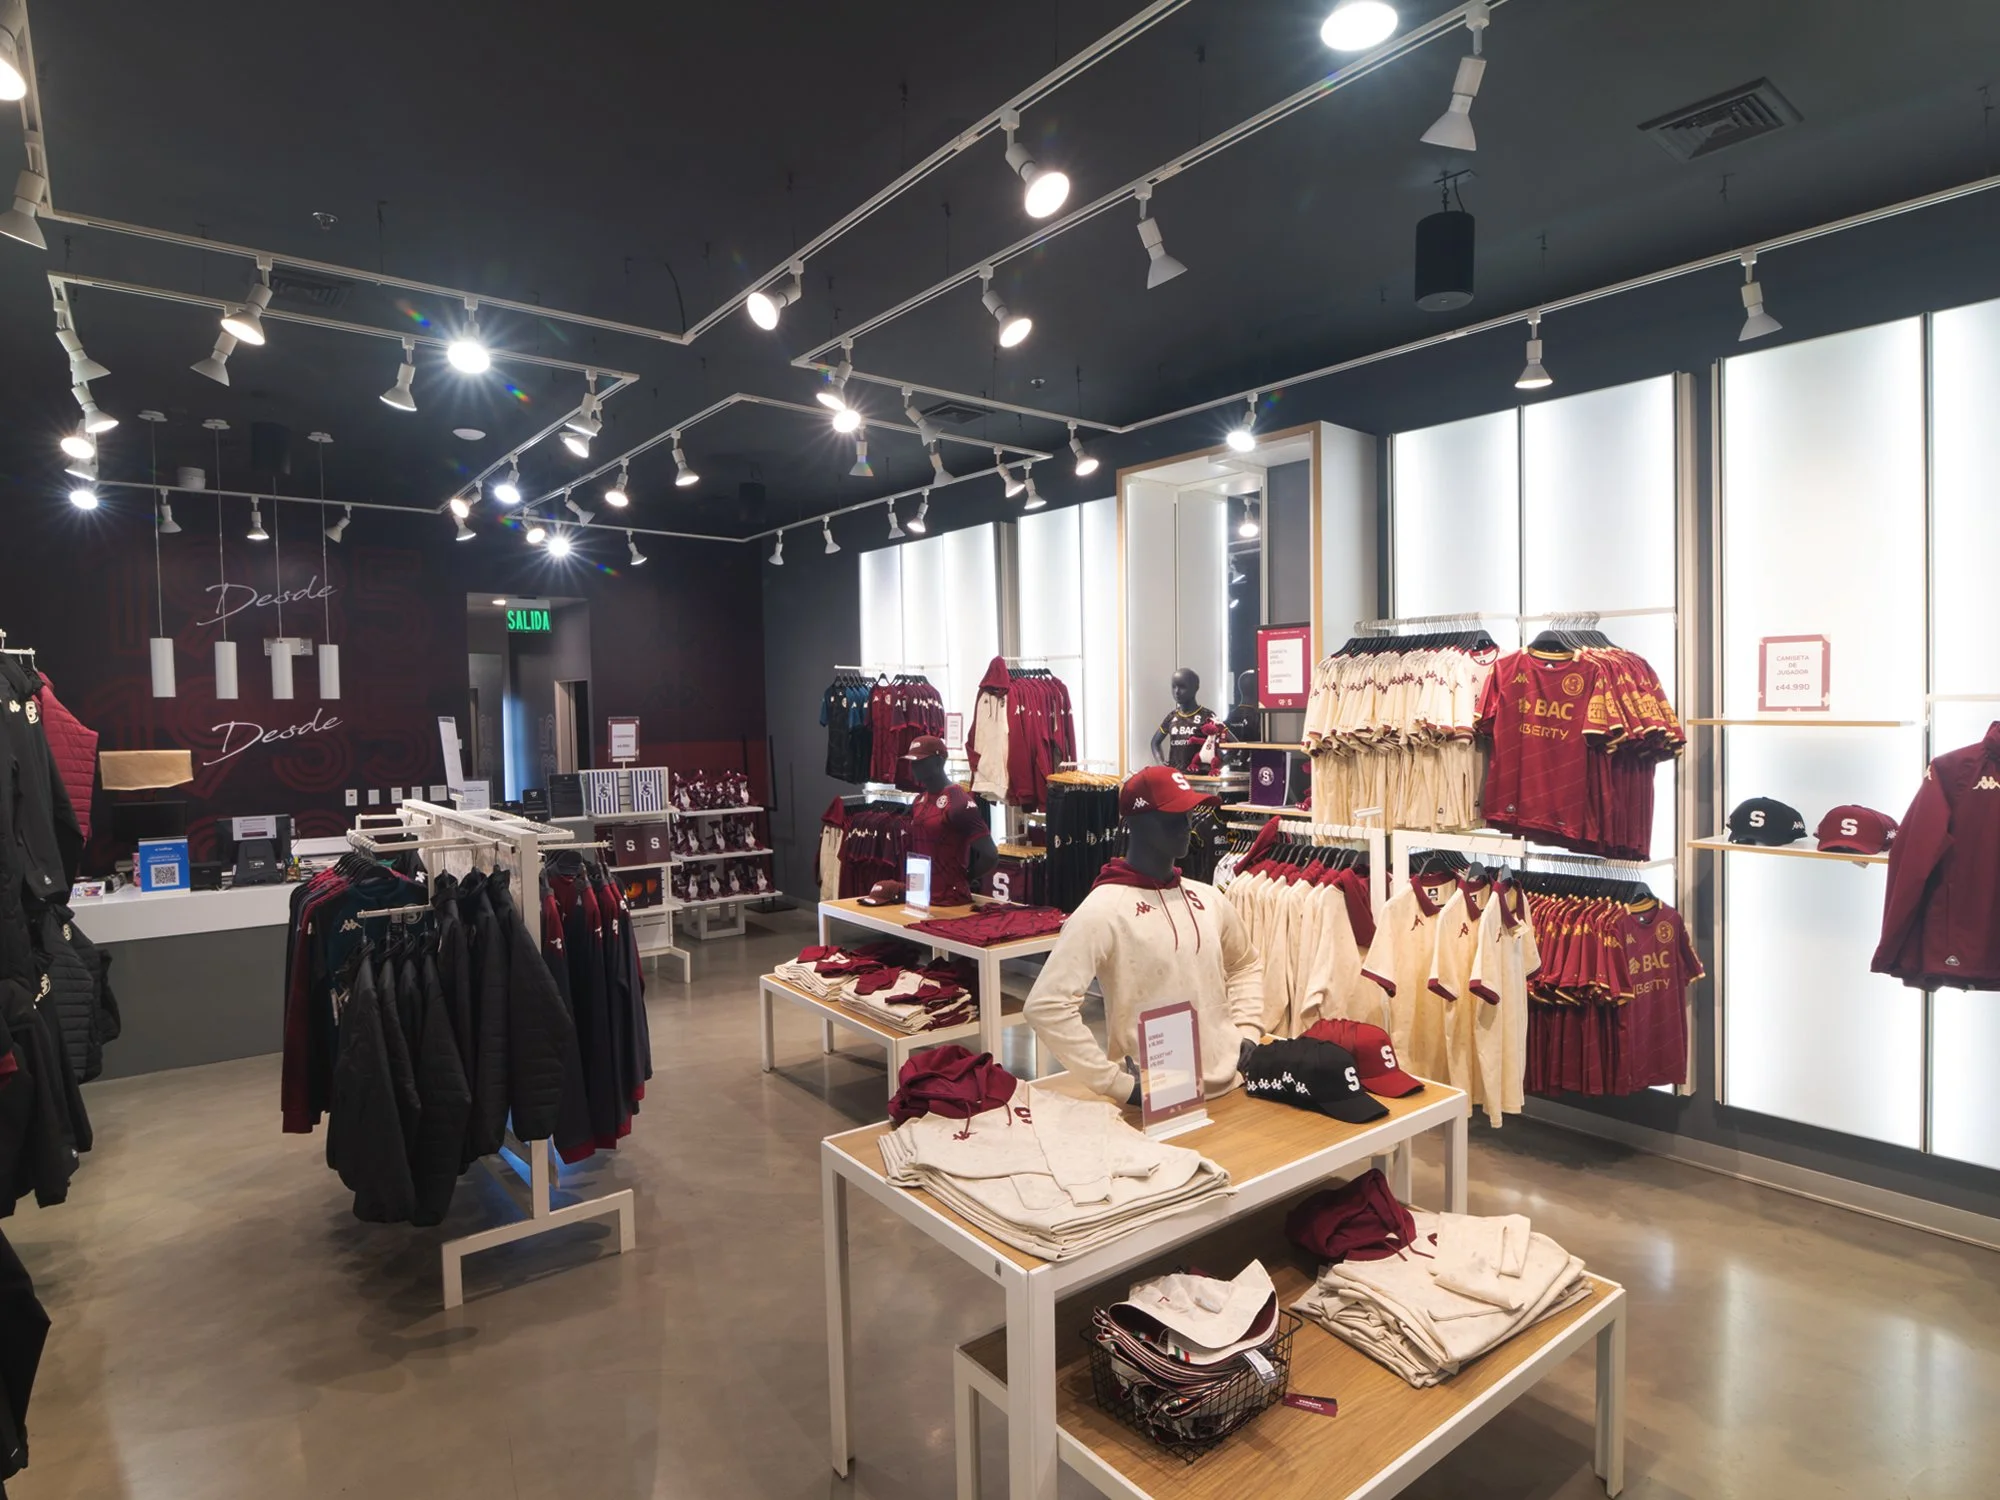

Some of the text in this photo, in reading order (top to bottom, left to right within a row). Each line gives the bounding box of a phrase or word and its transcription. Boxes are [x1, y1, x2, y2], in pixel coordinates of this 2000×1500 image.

[196, 575, 338, 626] Desde
[507, 609, 550, 631] SALIDA
[1193, 714, 1202, 724] S
[1534, 698, 1575, 721] BAC
[202, 707, 343, 766] Desde
[1171, 772, 1190, 791] S
[1262, 769, 1271, 782] S
[1750, 810, 1766, 828] S
[1840, 818, 1858, 836] S
[626, 839, 636, 852] S
[650, 837, 660, 849] S
[992, 871, 1011, 902] S
[1184, 889, 1205, 911] S
[1642, 950, 1670, 972] BAC
[1381, 1045, 1396, 1069] S
[1344, 1067, 1361, 1092] S
